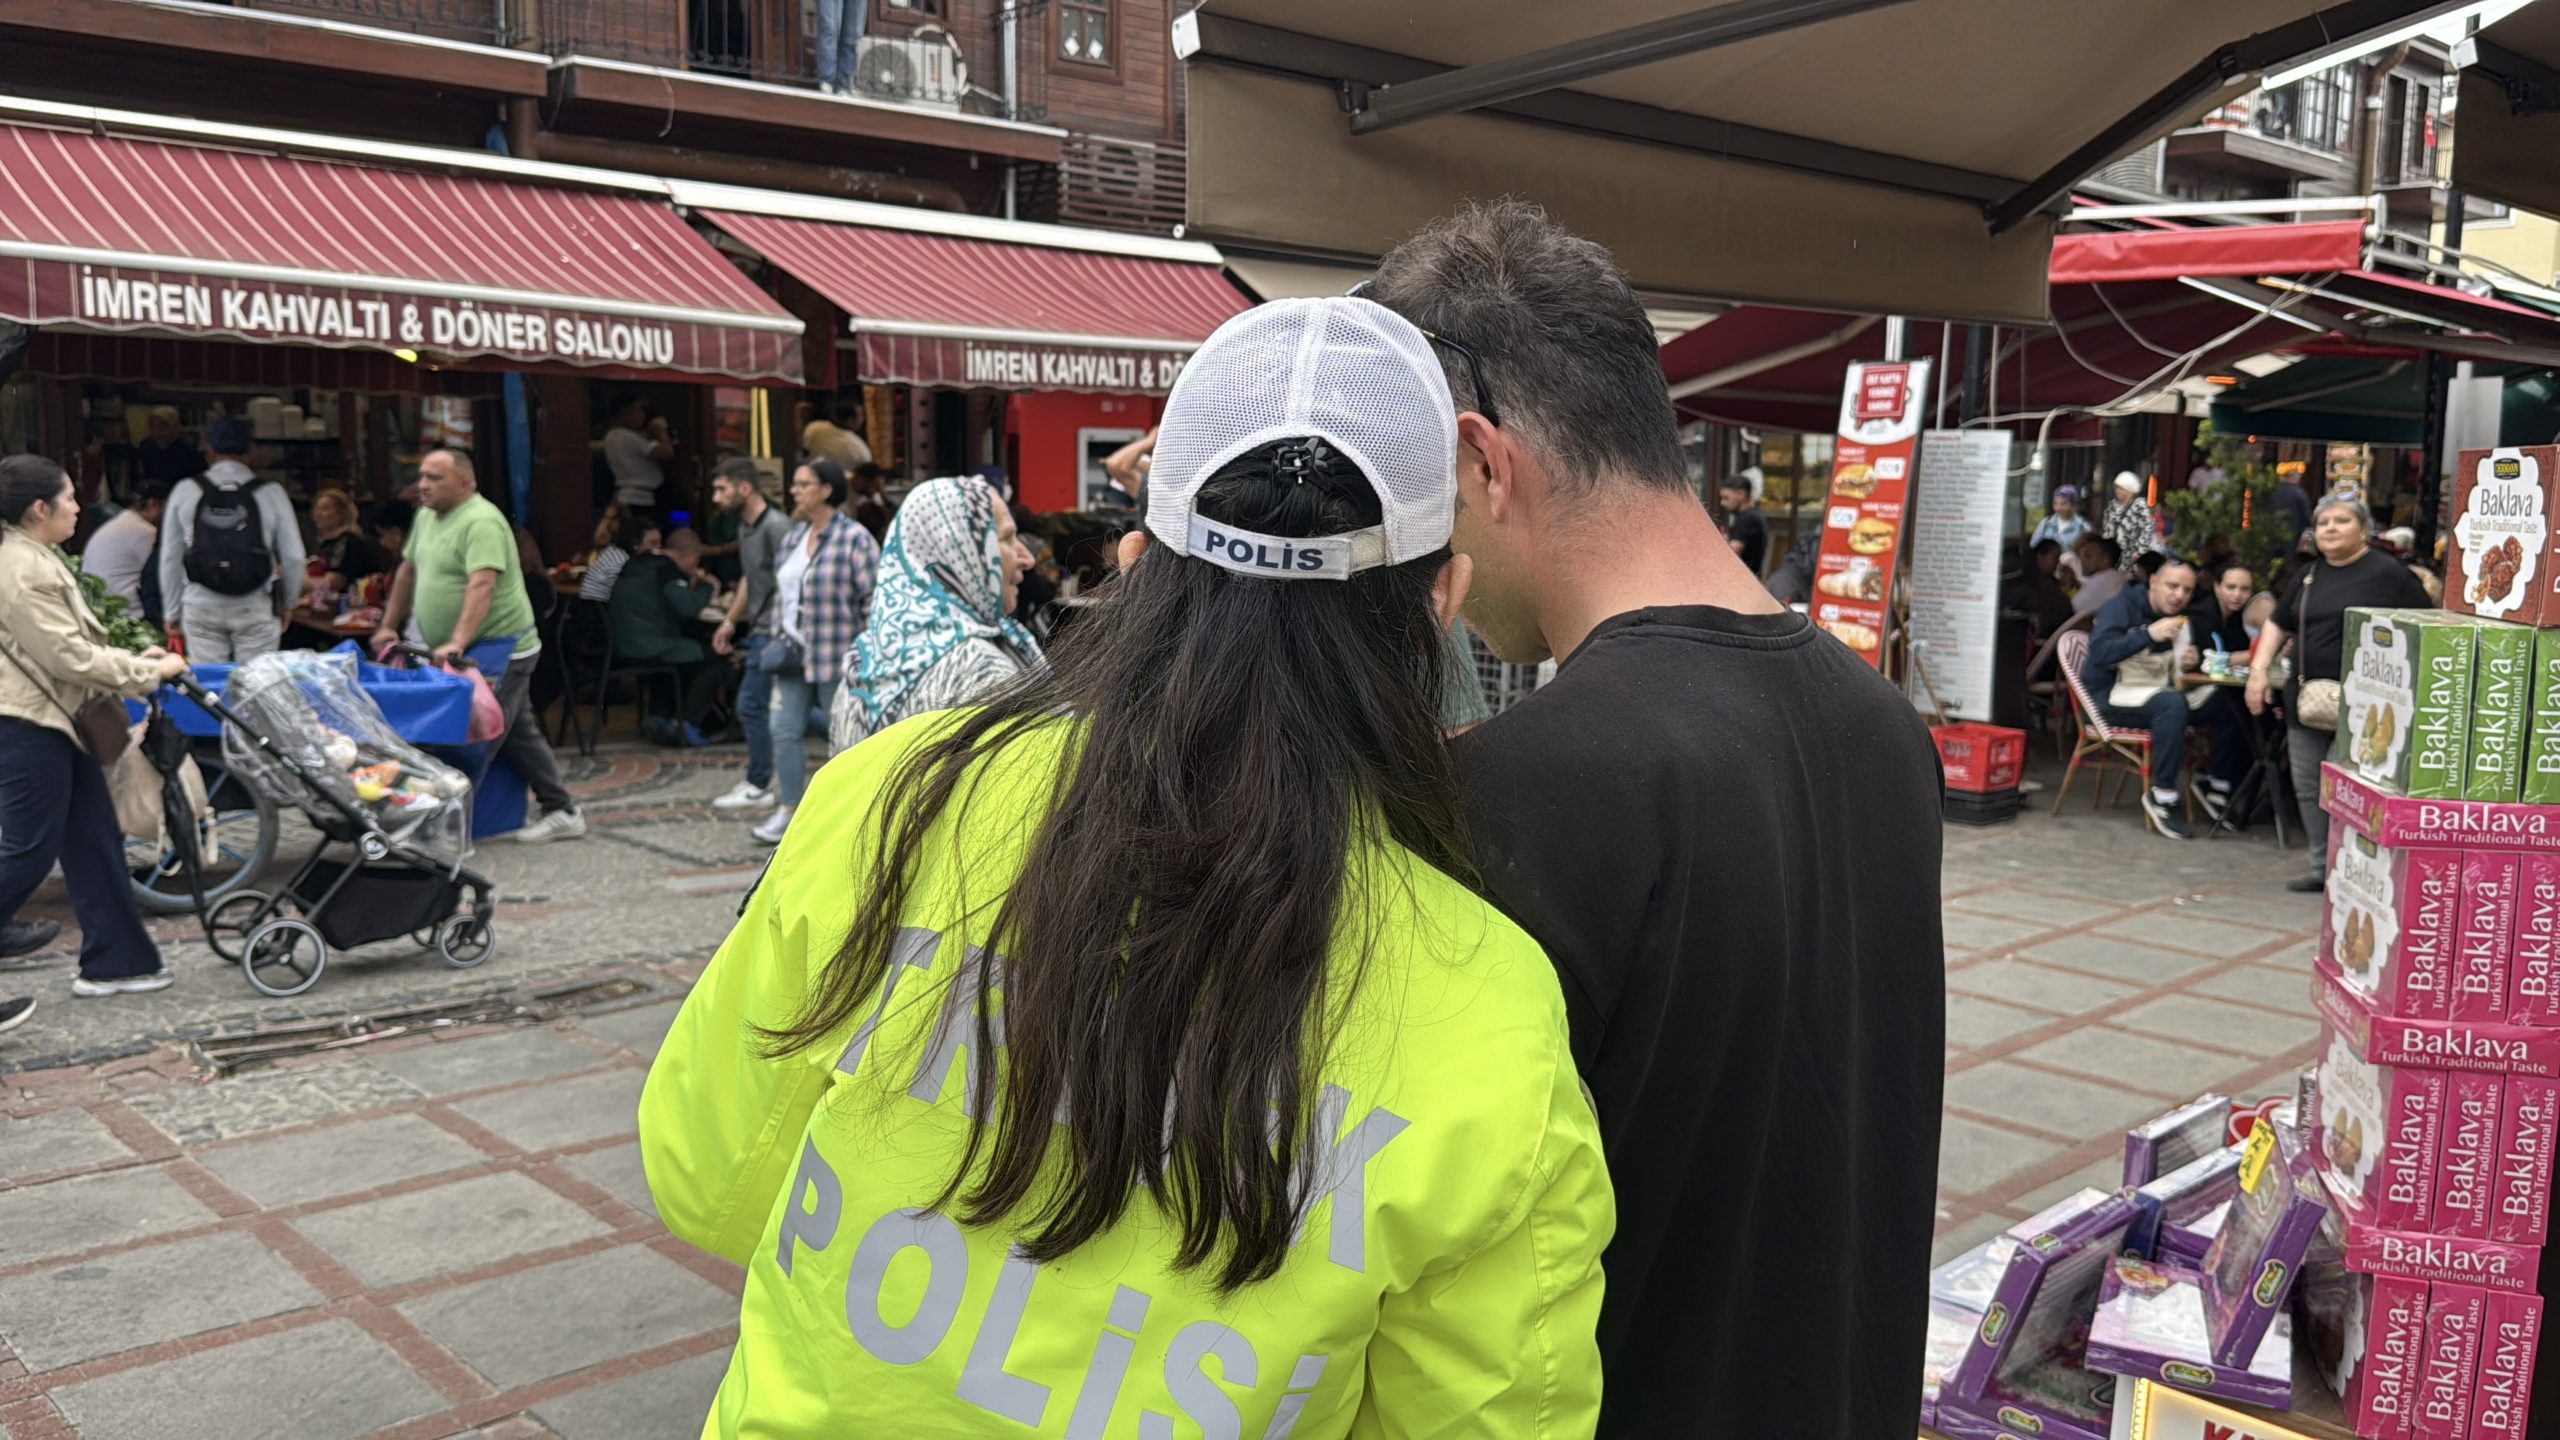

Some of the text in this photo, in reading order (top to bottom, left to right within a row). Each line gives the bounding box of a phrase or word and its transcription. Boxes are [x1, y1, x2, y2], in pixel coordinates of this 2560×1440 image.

[82, 265, 675, 364] İMREN KAHVALTI & DÖNER SALONU
[966, 341, 1038, 383] İMREN
[1041, 352, 1136, 387] KAHVALTI
[1139, 357, 1155, 388] &
[1205, 529, 1324, 571] POLİS
[2470, 519, 2492, 532] Turkish
[2493, 520, 2522, 533] Traditional
[2480, 484, 2533, 517] Baklava
[2362, 651, 2403, 689] Baklava
[2418, 656, 2453, 770] Baklava
[2445, 637, 2468, 788] Turkish Traditional Taste
[2475, 658, 2513, 773] Baklava
[2502, 640, 2527, 792] Turkish Traditional Taste
[2398, 829, 2448, 842] Turkish
[2451, 831, 2526, 845] Traditional
[2419, 804, 2546, 834] Baklava
[2407, 880, 2443, 991] Baklava
[2432, 862, 2458, 1009] Turkish Traditional Taste
[2463, 882, 2498, 993] Baklava
[2489, 864, 2514, 1012] Turkish Traditional Taste
[2519, 884, 2556, 996] Baklava
[2381, 1051, 2548, 1074] Turkish Traditional Taste
[2402, 1028, 2528, 1061] Baklava
[2389, 1094, 2425, 1204] Baklava
[2413, 1078, 2441, 1222] Turkish Traditional Taste
[2445, 1100, 2482, 1209] Baklava
[2471, 1084, 2498, 1228] Turkish Traditional Taste
[2503, 1105, 2540, 1215] Baklava
[2528, 1088, 2556, 1234] Turkish Traditional Taste
[2360, 1258, 2525, 1289] Turkish Traditional Taste
[2382, 1237, 2507, 1275] Baklava
[2372, 1307, 2409, 1415] Baklava
[2396, 1292, 2425, 1433] Turkish Traditional Taste
[2426, 1313, 2465, 1421] Baklava
[2456, 1330, 2475, 1396] Traditional
[2466, 1298, 2480, 1330] Taste
[2482, 1322, 2521, 1430] Baklava
[2508, 1307, 2537, 1440] urkish Traditional Taste
